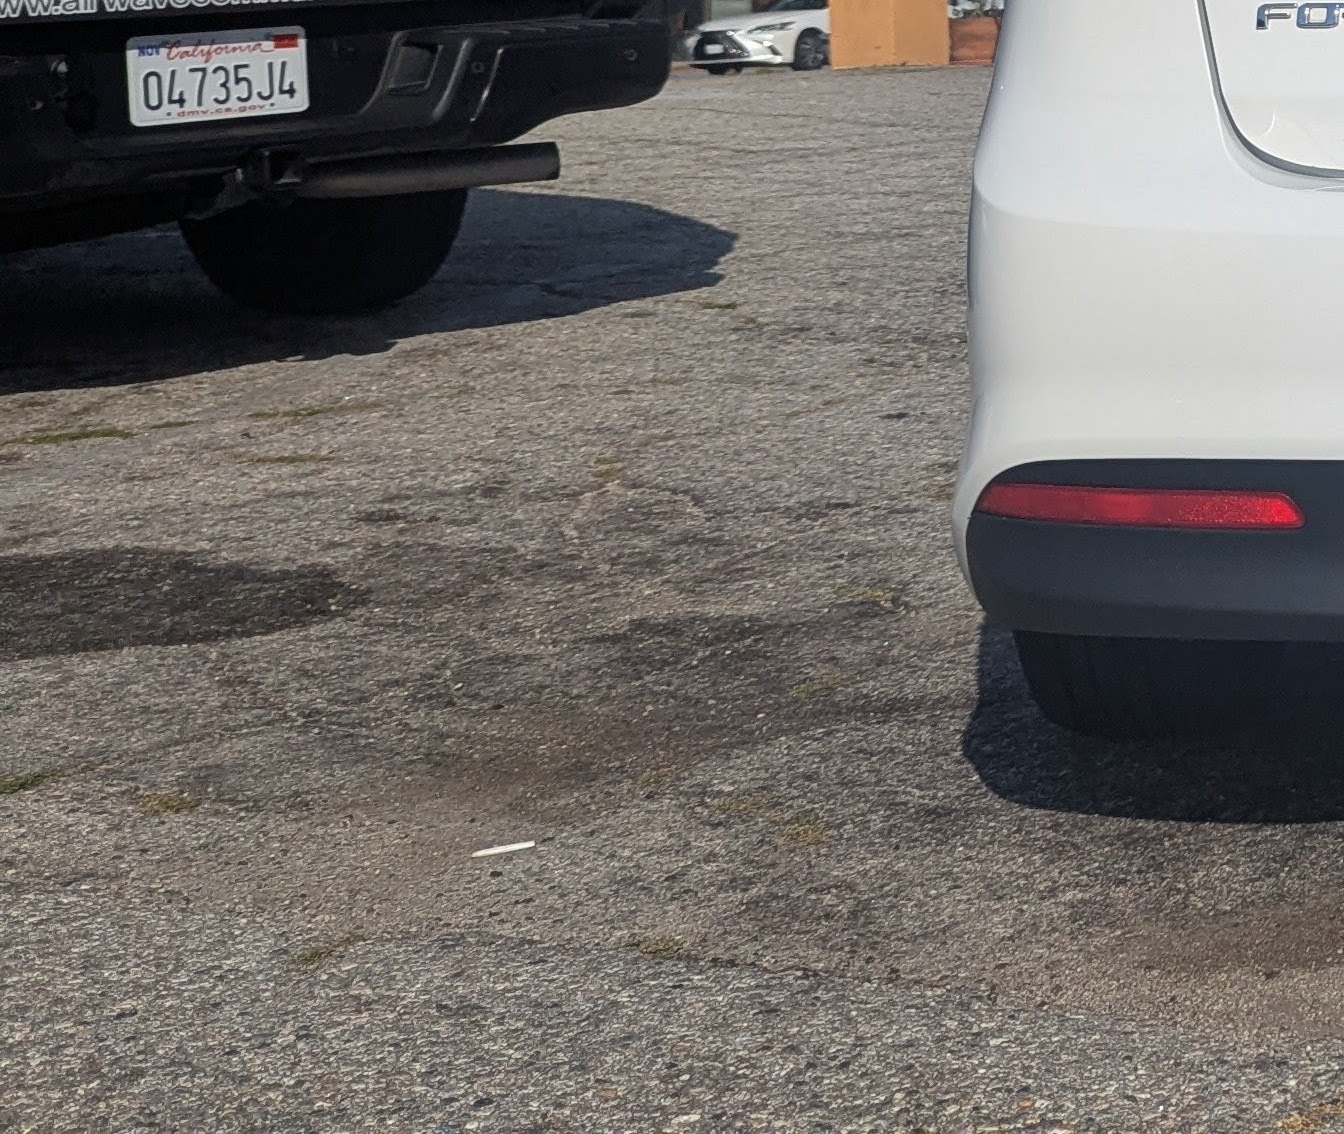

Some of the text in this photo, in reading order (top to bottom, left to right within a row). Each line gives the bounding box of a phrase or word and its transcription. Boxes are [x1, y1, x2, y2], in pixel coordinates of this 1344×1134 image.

[165, 38, 275, 64] California
[142, 60, 297, 112] 04735J4
[176, 103, 268, 117] dmv.ca.gov
